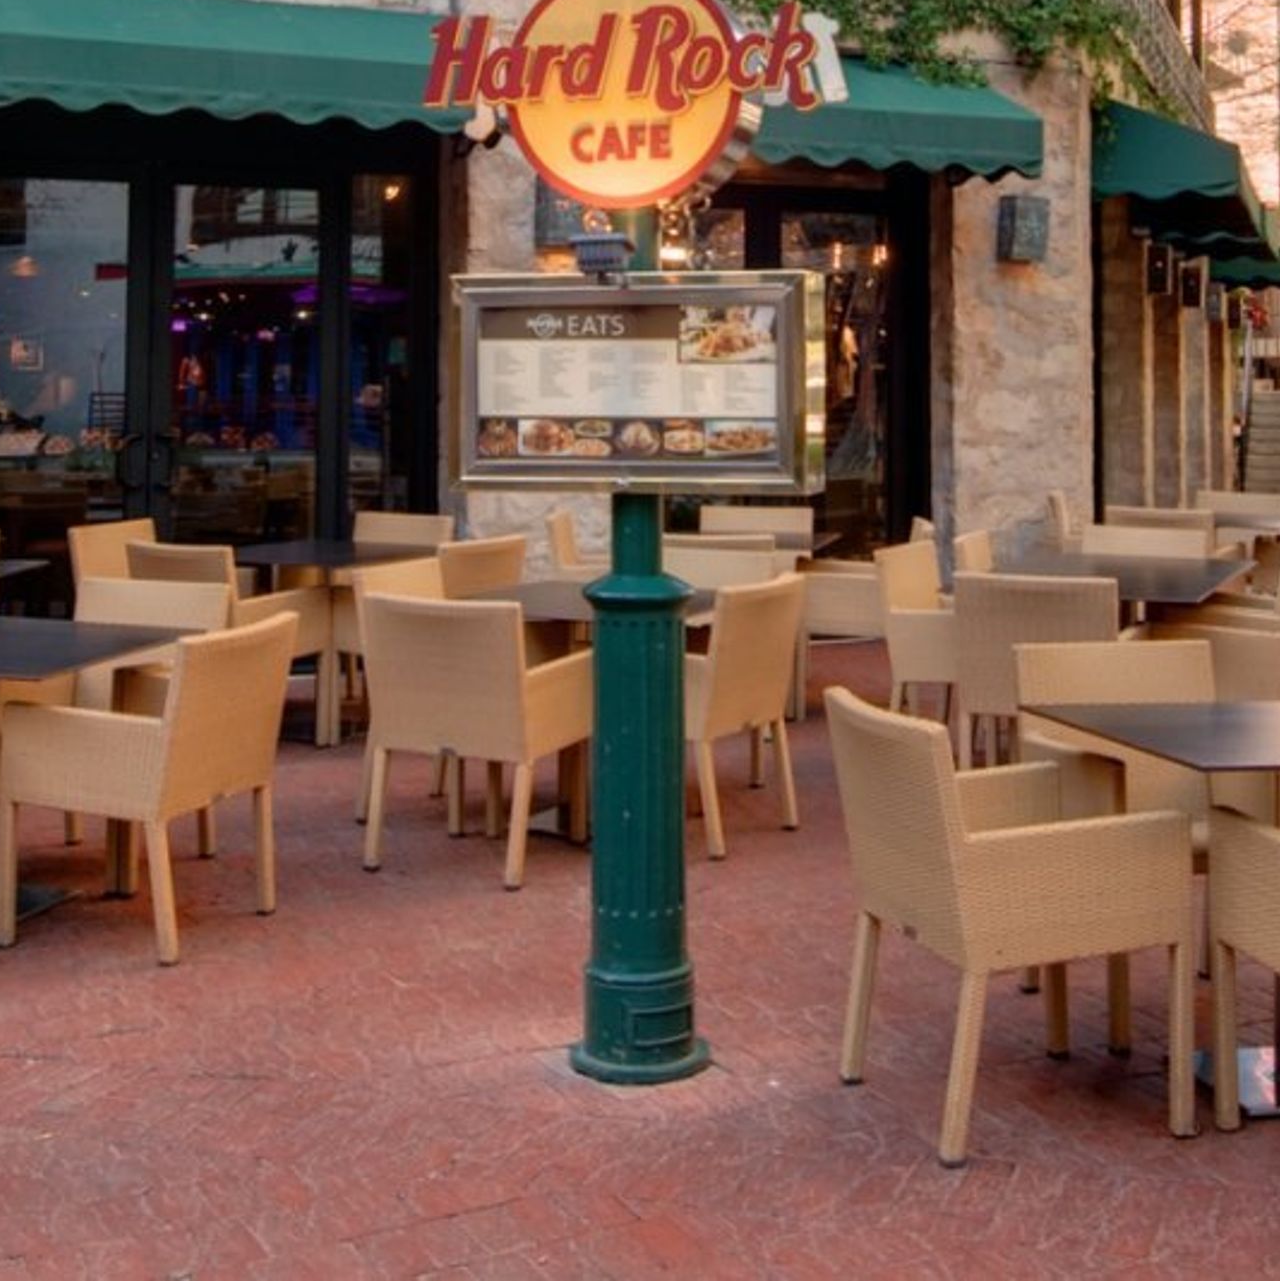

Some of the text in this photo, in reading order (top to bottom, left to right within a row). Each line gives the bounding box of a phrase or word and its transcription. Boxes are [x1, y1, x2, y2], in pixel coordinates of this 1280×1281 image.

[424, 1, 818, 112] Hard Rock
[570, 123, 672, 163] CAFE
[567, 314, 625, 336] EATS
